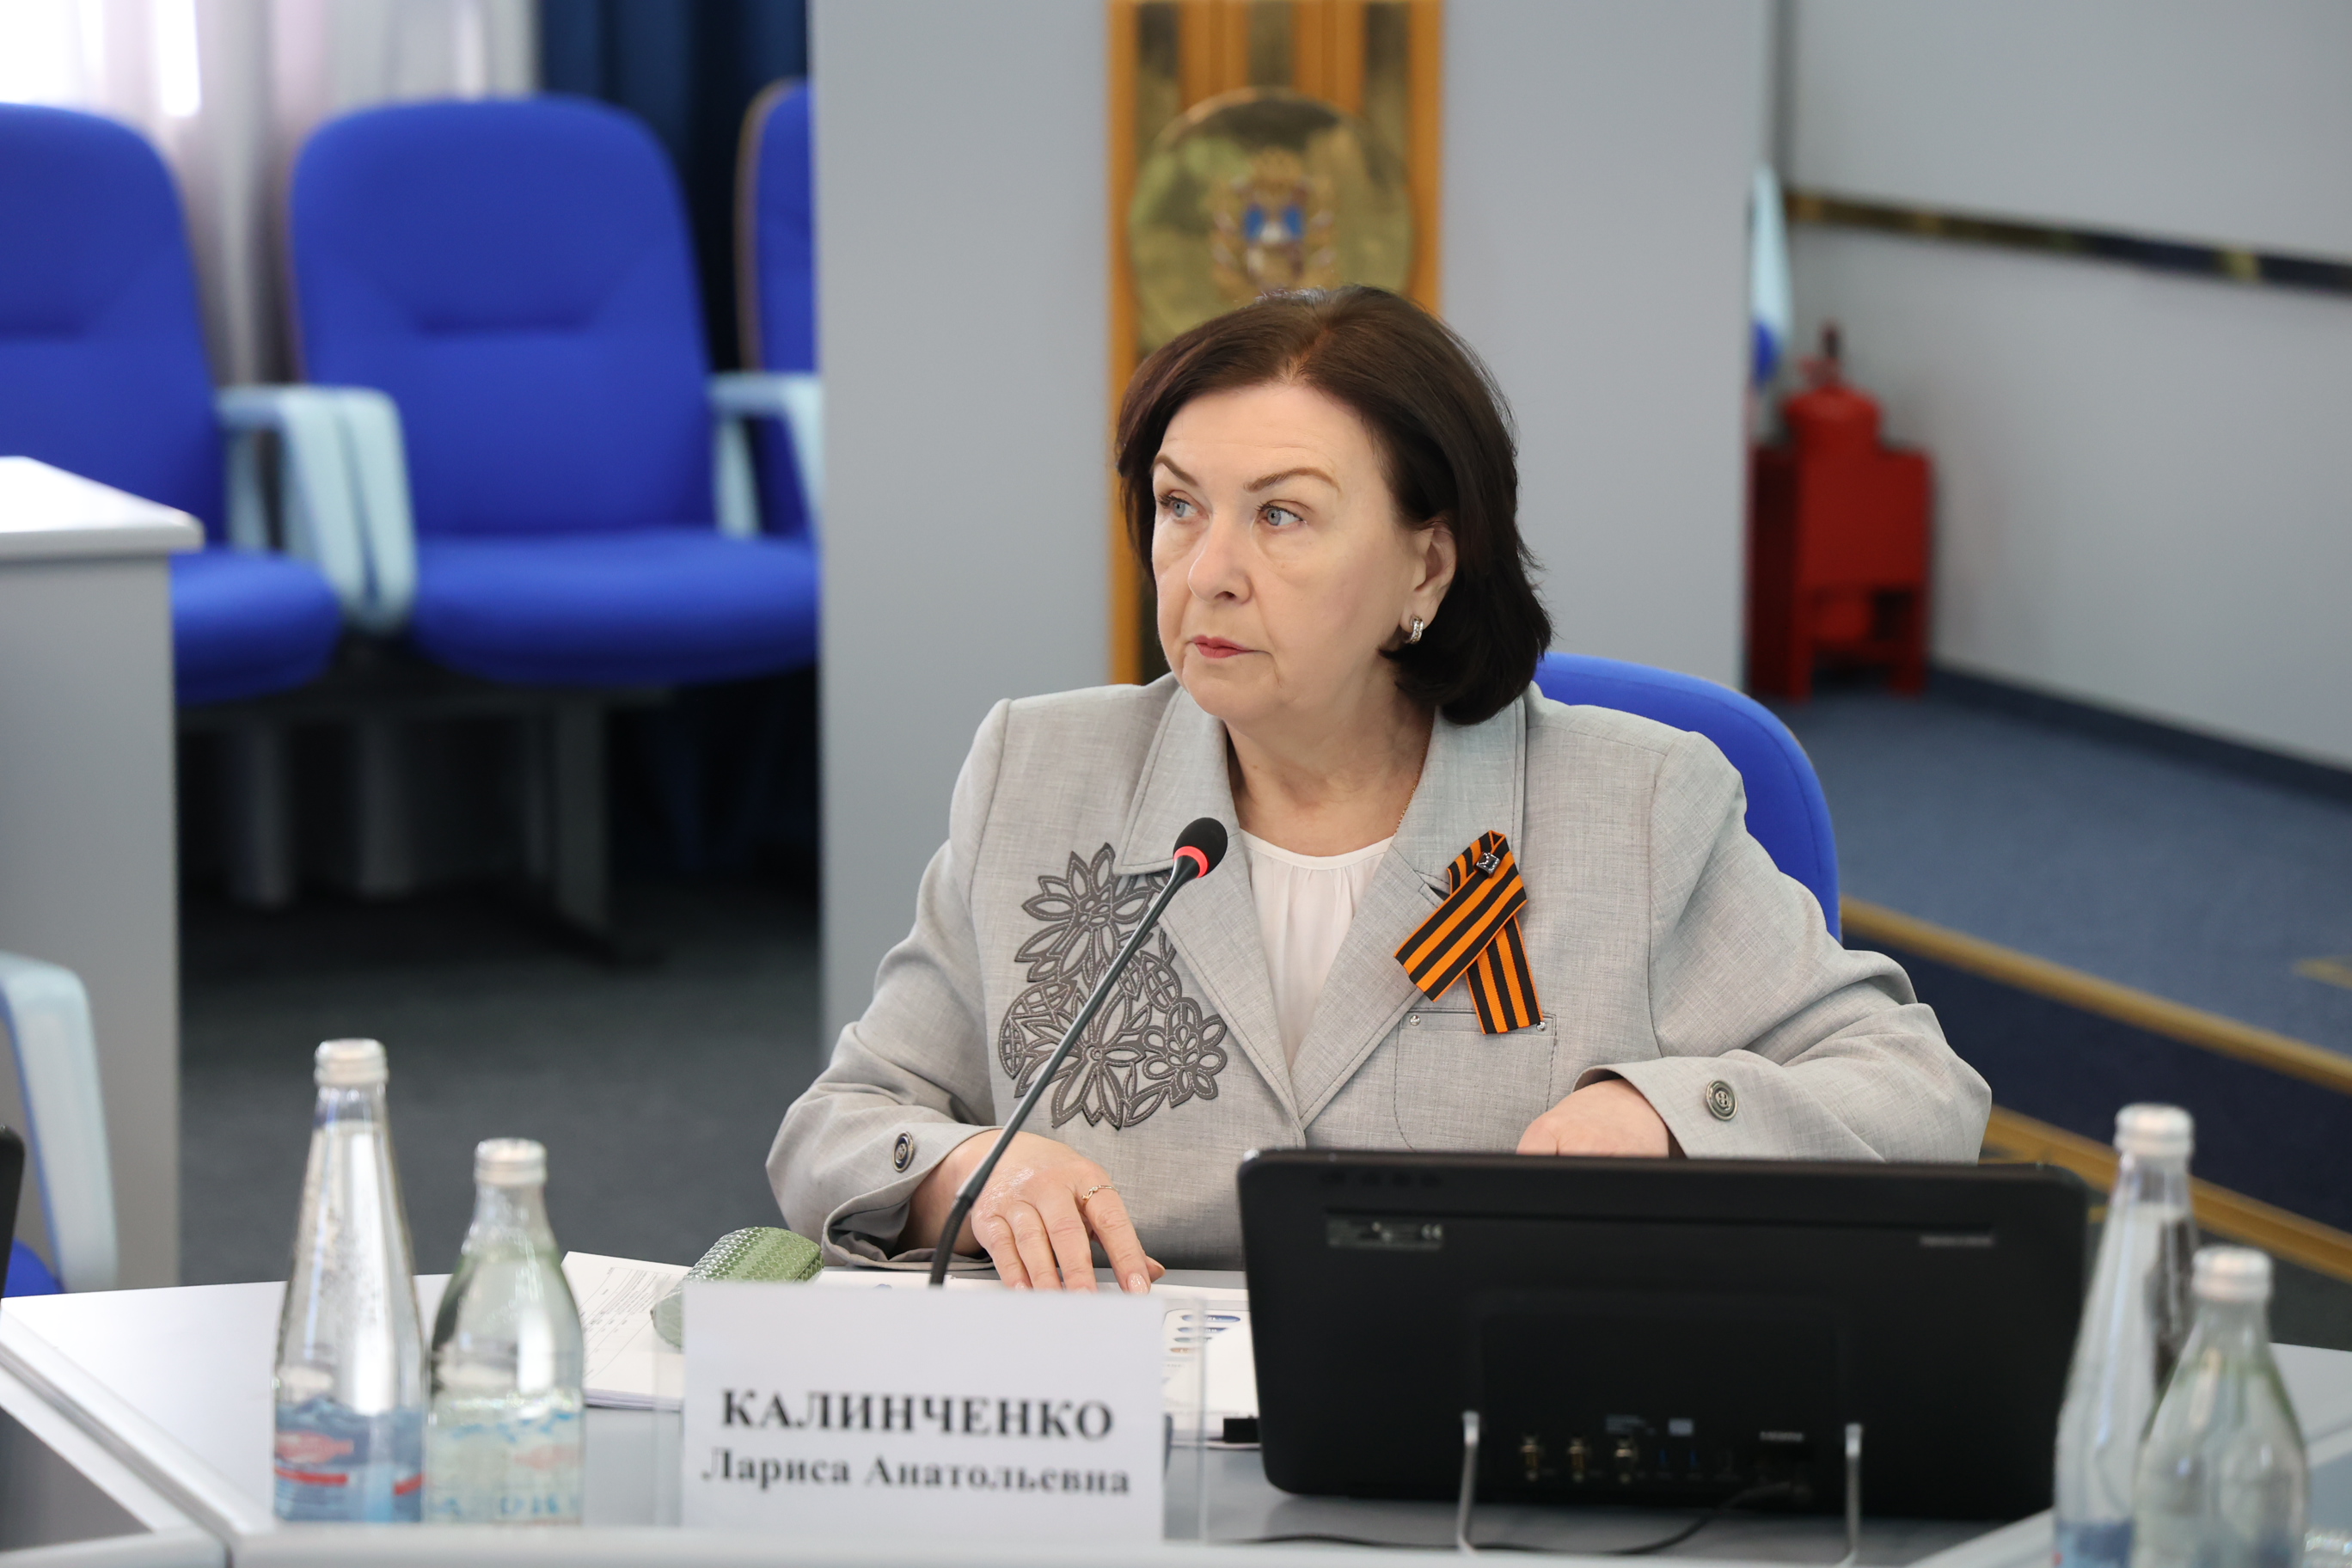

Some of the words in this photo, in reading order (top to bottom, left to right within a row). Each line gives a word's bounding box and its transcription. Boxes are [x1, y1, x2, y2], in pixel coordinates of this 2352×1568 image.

[720, 1387, 1114, 1441] КАЛИНЧЕНКО
[702, 1448, 851, 1492] Лариса
[865, 1455, 1131, 1498] Анатольевна
